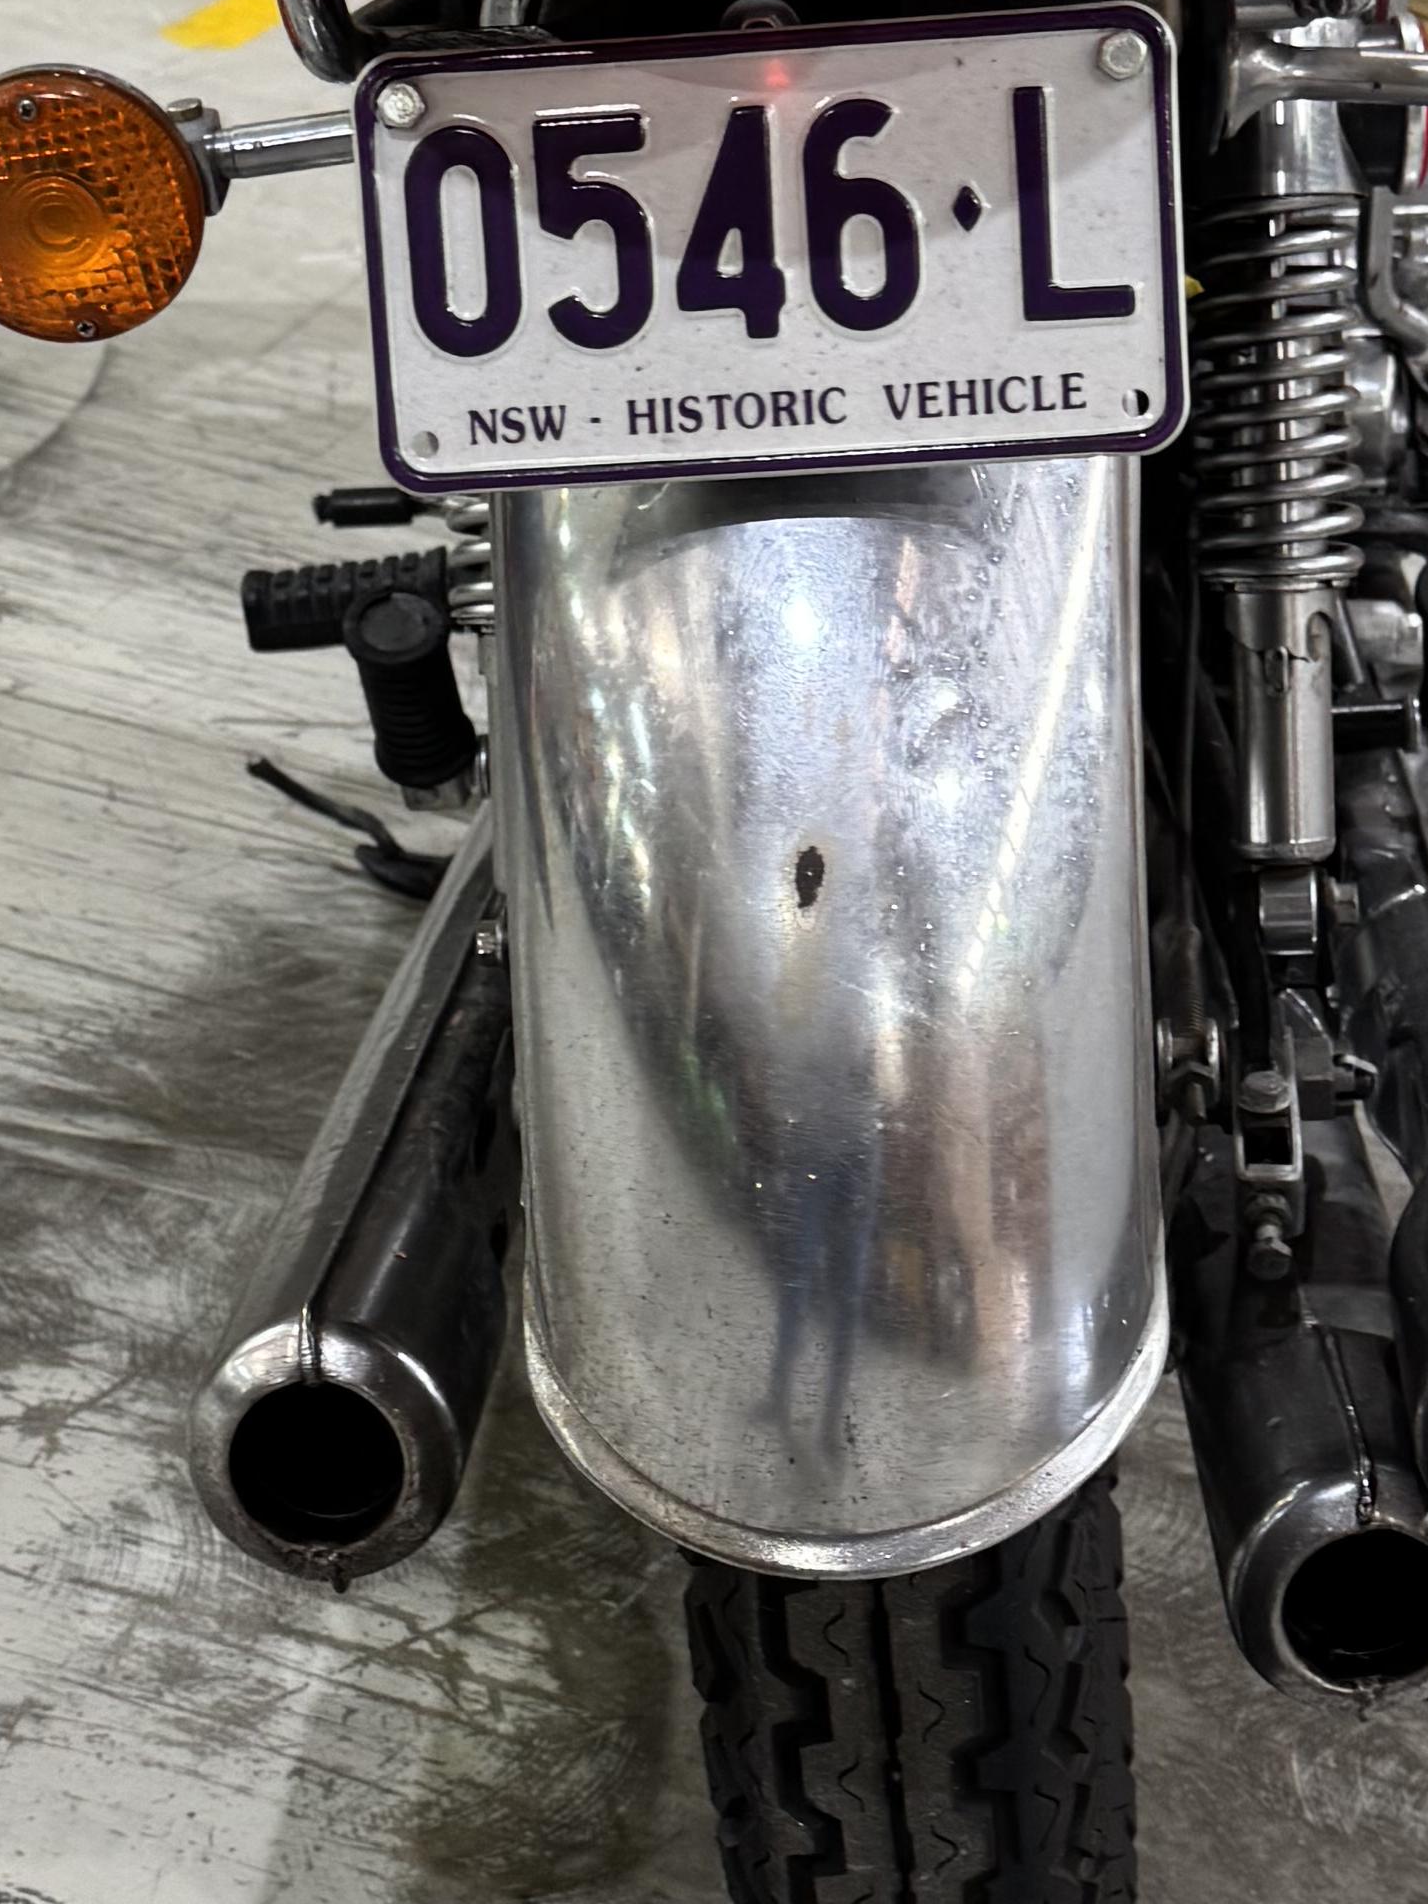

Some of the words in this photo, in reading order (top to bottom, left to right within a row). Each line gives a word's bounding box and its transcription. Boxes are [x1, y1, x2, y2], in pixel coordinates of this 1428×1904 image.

[468, 405, 567, 445] NSW
[627, 386, 847, 435] HISTORIC
[883, 372, 1088, 420] VEHICLE
